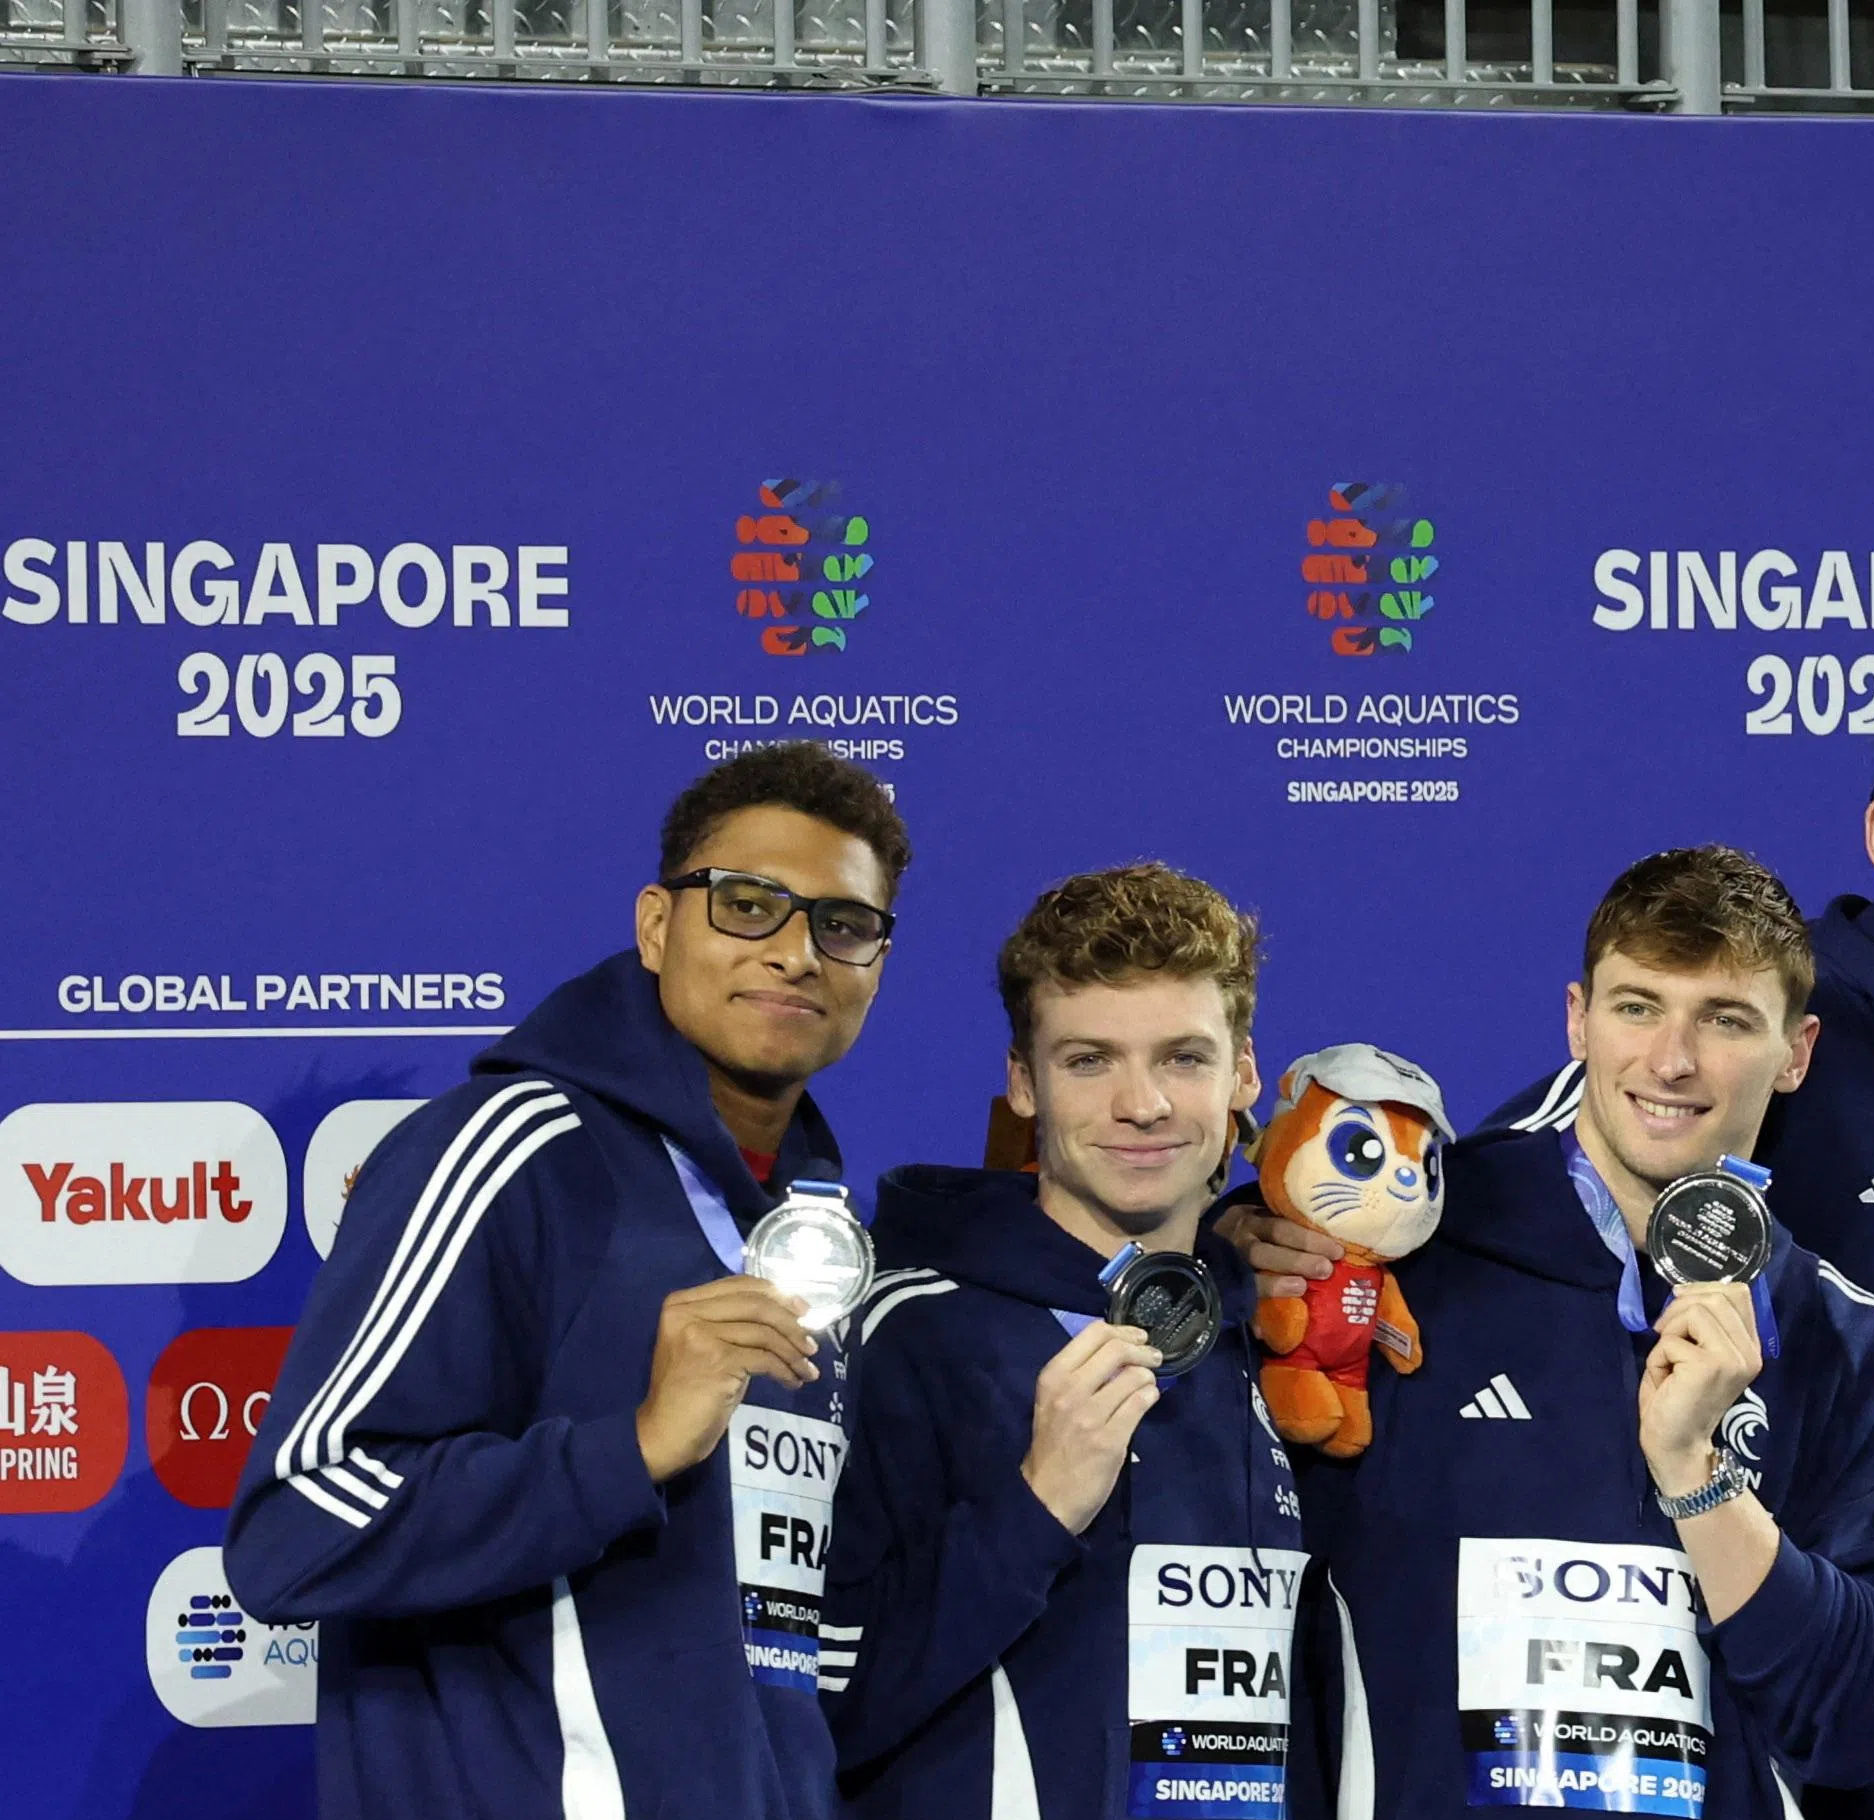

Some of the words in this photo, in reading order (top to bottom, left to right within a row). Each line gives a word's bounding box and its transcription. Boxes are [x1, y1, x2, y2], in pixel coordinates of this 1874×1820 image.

[2, 537, 570, 628] SINGAPORE
[176, 652, 402, 738] 2025
[650, 695, 779, 725] WORLD
[788, 694, 959, 728] AQUATICS
[1224, 694, 1348, 725] WORLD
[1356, 694, 1520, 726] AQUATICS
[705, 738, 905, 761] CHASHIPS
[1276, 738, 1468, 759] CHAMPIONSHIPS
[1287, 780, 1408, 803] SINGAPORE
[1410, 780, 1459, 802] 2025
[58, 975, 247, 1013] GLOBAL
[256, 972, 506, 1011] PARTNERS
[21, 1161, 253, 1225] Yakult
[0, 1365, 79, 1436] 山泉
[0, 1446, 78, 1481] PRING
[1158, 1562, 1297, 1610] SONY
[766, 1600, 806, 1621] WORLD
[1185, 1648, 1287, 1699] FRA
[1526, 1638, 1694, 1700] FRA
[1191, 1734, 1246, 1750] WORLD
[1617, 1727, 1706, 1755] AQUATICS
[1155, 1778, 1271, 1802] SINGAPORE
[1661, 1776, 1705, 1803] 202
